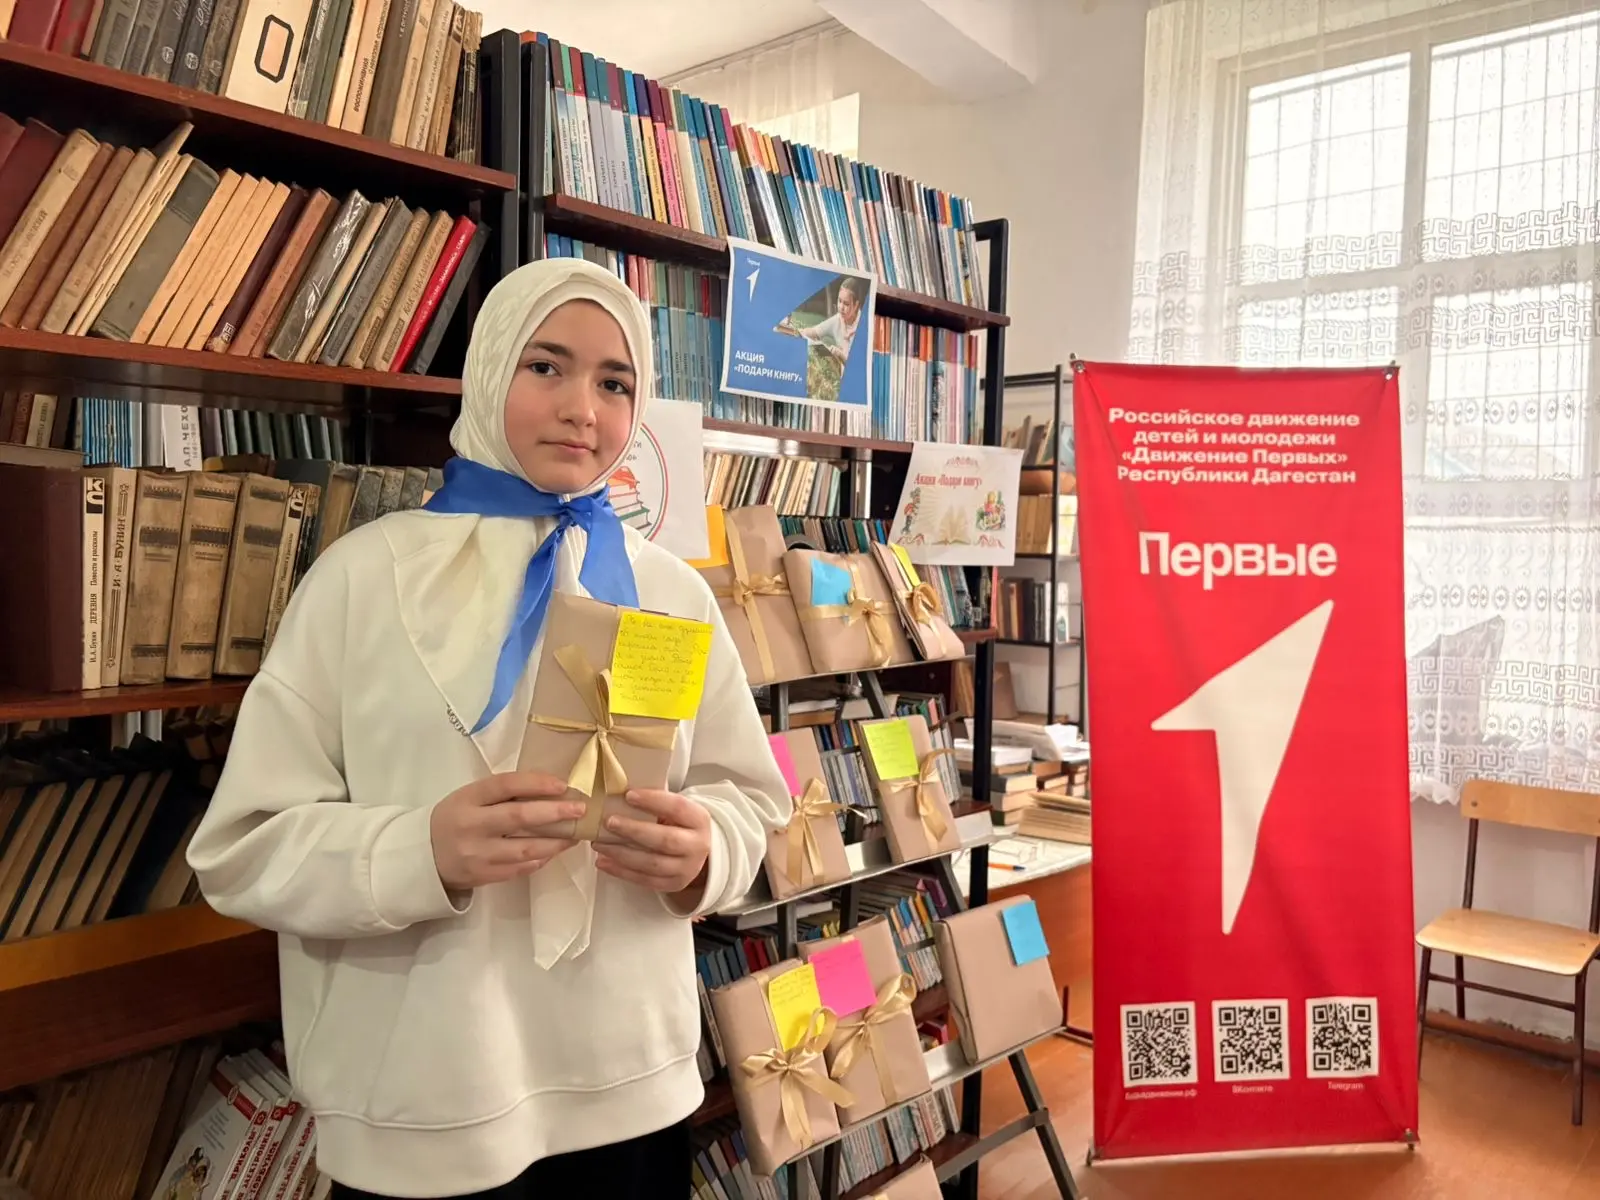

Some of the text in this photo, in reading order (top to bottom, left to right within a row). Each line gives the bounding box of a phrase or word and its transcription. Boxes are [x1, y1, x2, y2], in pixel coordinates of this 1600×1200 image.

[735, 350, 764, 363] АКЦИЯ
[734, 364, 803, 382] «ПОДАРИ КНИГУ»
[180, 404, 189, 440] ЧЕХО
[1108, 408, 1360, 429] Российское движение
[1133, 428, 1336, 446] детей и молодежи
[1122, 448, 1348, 467] «Движение Первых»
[1118, 465, 1357, 486] Республики Дагестан
[1139, 531, 1338, 590] Первые
[89, 593, 97, 623] ДЕРЕВНЯ
